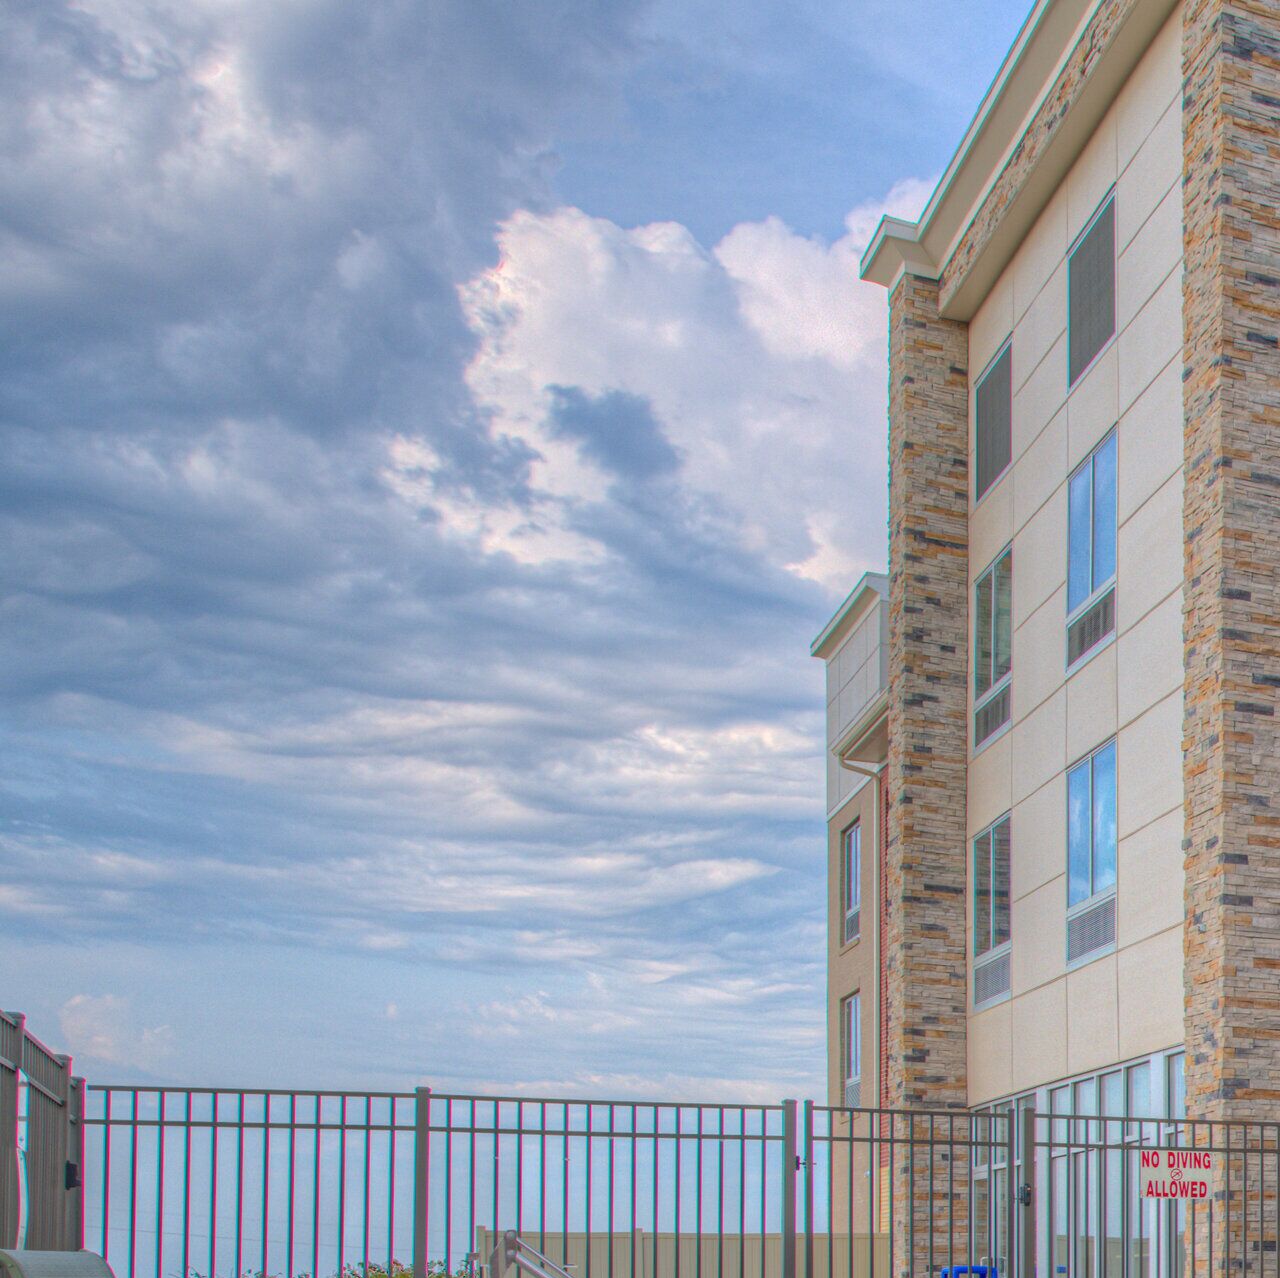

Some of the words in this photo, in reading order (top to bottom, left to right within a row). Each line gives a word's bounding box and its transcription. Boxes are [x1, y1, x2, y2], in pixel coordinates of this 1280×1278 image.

[1141, 1151, 1160, 1168] NO
[1167, 1151, 1212, 1169] DIVING
[1145, 1180, 1208, 1198] ALLOWED
